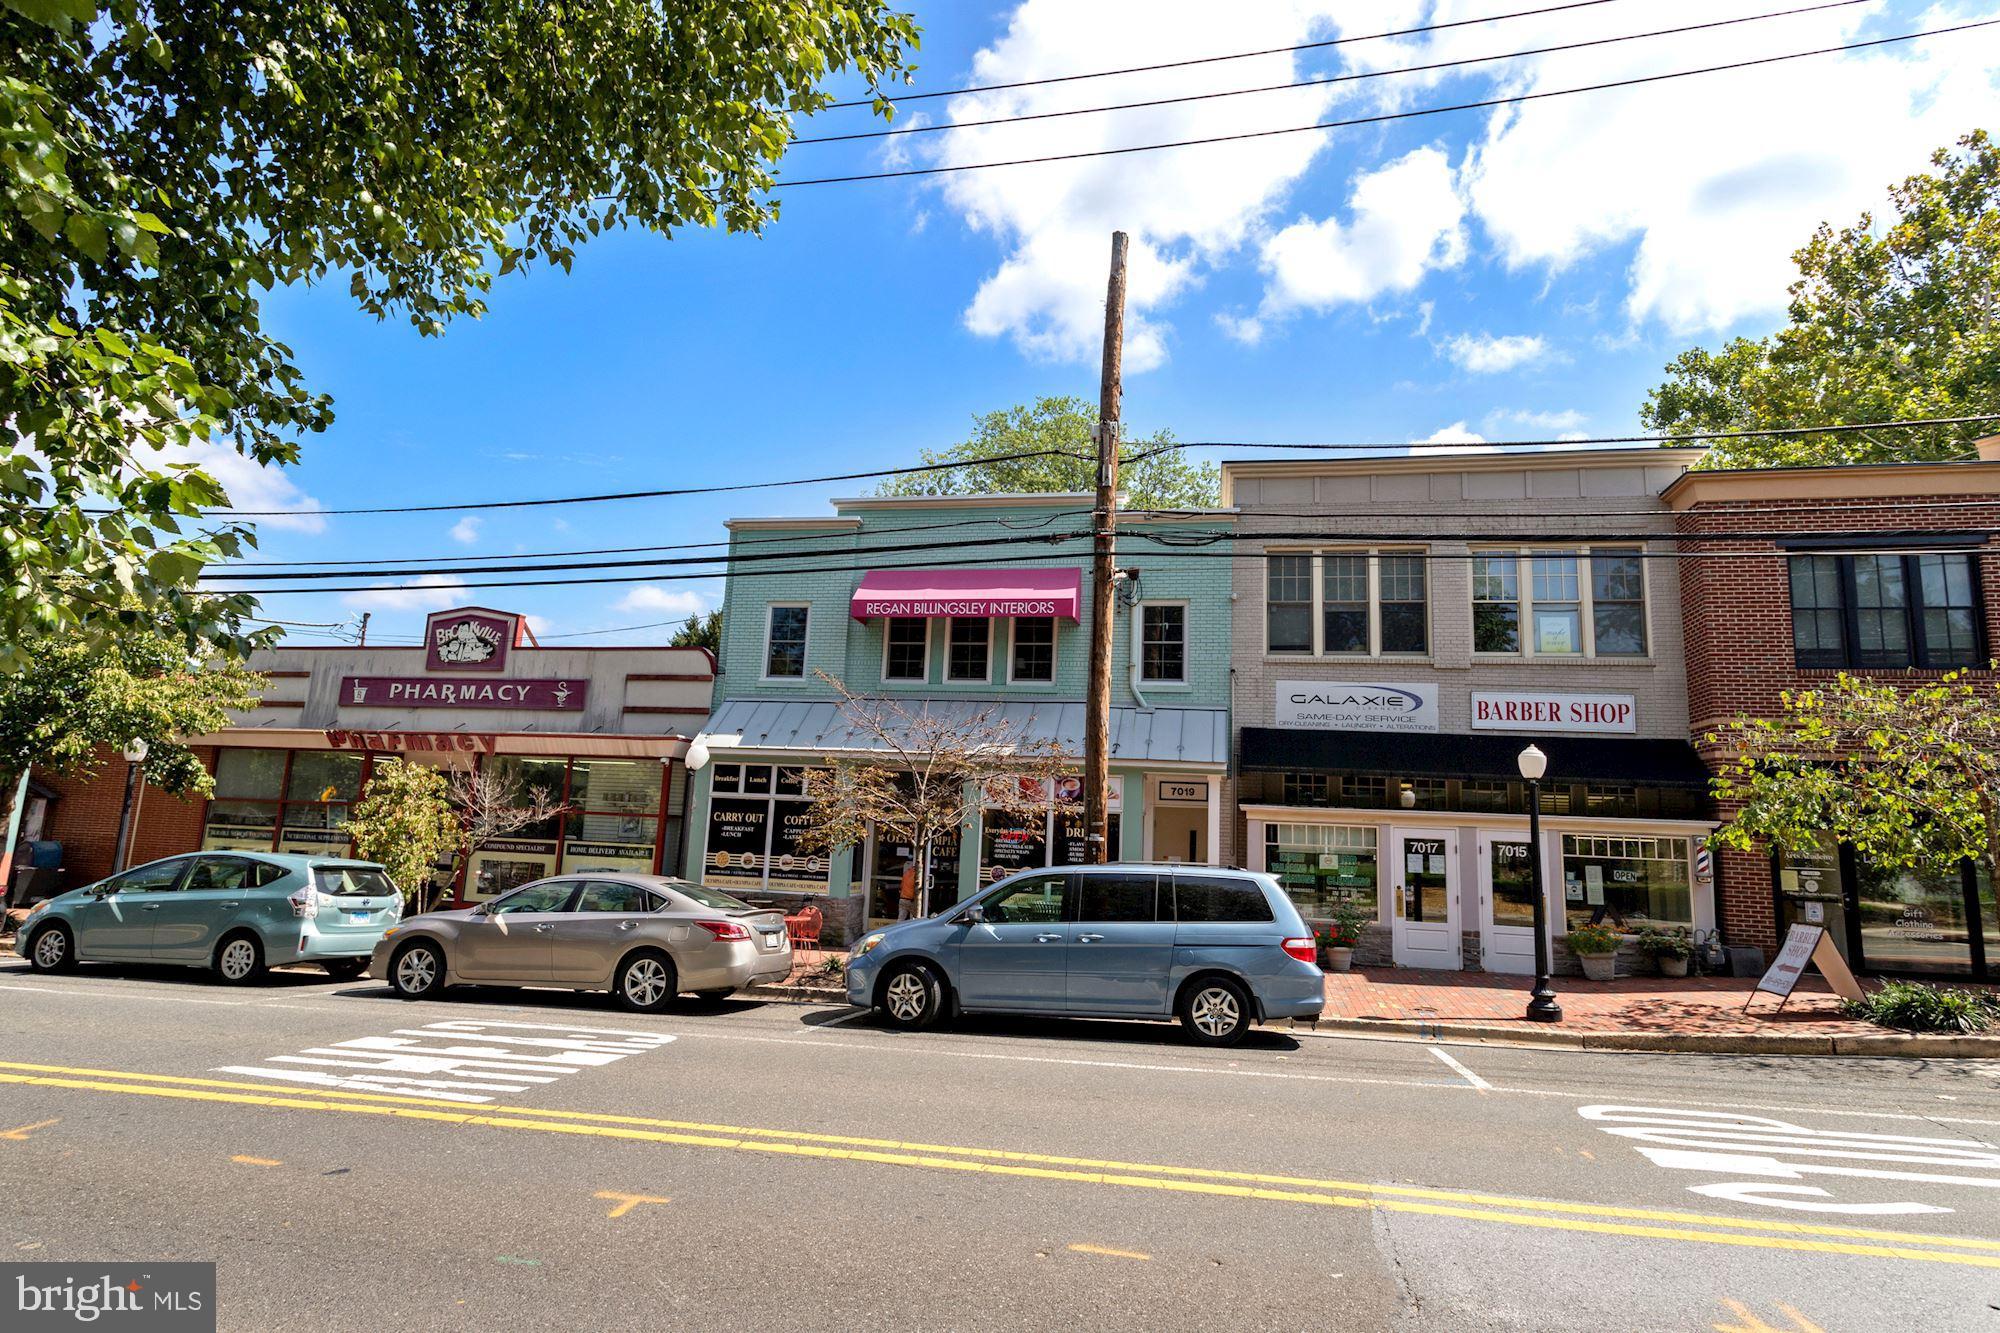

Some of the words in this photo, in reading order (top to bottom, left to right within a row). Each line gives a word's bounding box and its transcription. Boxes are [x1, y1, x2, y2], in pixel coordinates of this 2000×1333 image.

[866, 602, 911, 614] REGAN
[914, 602, 985, 614] BILLINGSLEY
[989, 601, 1055, 614] INTERIORS
[435, 620, 502, 646] BROKVILLE
[389, 683, 531, 704] PHARMACY
[1290, 694, 1404, 707] GALAXIE
[1296, 712, 1362, 722] SAME-DAY
[1364, 714, 1417, 723] SERVICE
[1476, 700, 1562, 722] BARBER
[1570, 702, 1631, 724] SHOP
[1386, 723, 1436, 731] ALTERATIONS
[1171, 787, 1195, 796] 7019
[713, 811, 744, 822] CARRY
[745, 813, 764, 823] OUT
[483, 842, 515, 851] COMPOUND
[515, 844, 546, 852] SPECIALIST
[569, 845, 587, 854] HOME
[588, 847, 616, 856] DELIVERY
[618, 848, 650, 857] AVAILABLE
[931, 846, 958, 858] CAFE
[1409, 841, 1439, 854] 7017
[1498, 844, 1527, 858] 7015
[1614, 870, 1637, 881] OPEN
[1903, 909, 1923, 919] Gift
[1895, 919, 1934, 931] Clothing
[1789, 930, 1819, 945] BARBER
[1887, 930, 1944, 941] Accessories
[1786, 943, 1809, 958] SHOP
